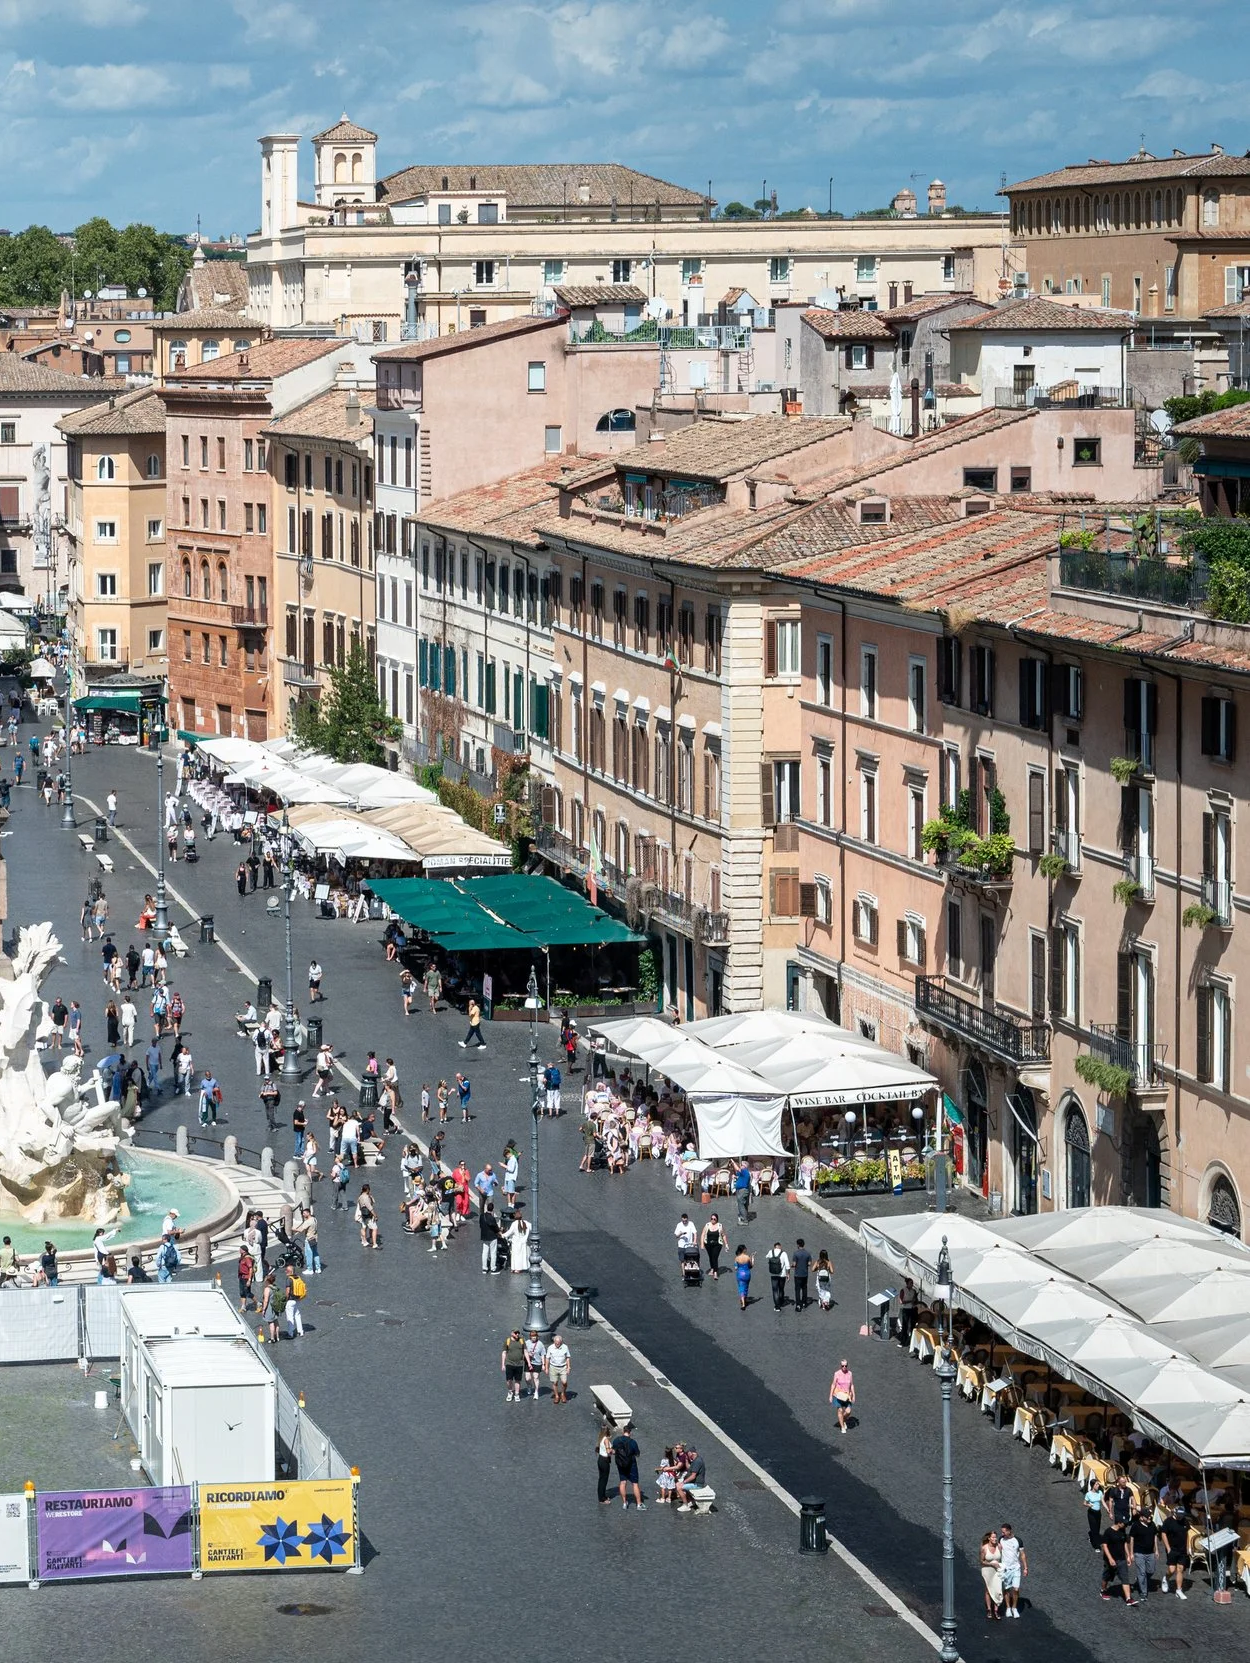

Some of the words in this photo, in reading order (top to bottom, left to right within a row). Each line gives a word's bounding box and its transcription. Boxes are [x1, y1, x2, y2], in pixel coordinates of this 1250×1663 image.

[794, 1096, 823, 1106] WINE
[824, 1096, 846, 1104] BAR
[856, 1091, 907, 1102] COCKTAIL
[892, 1155, 900, 1180] ATM
[45, 1496, 133, 1511] RESTAURIAMO
[206, 1490, 285, 1503] RICORDIAMO
